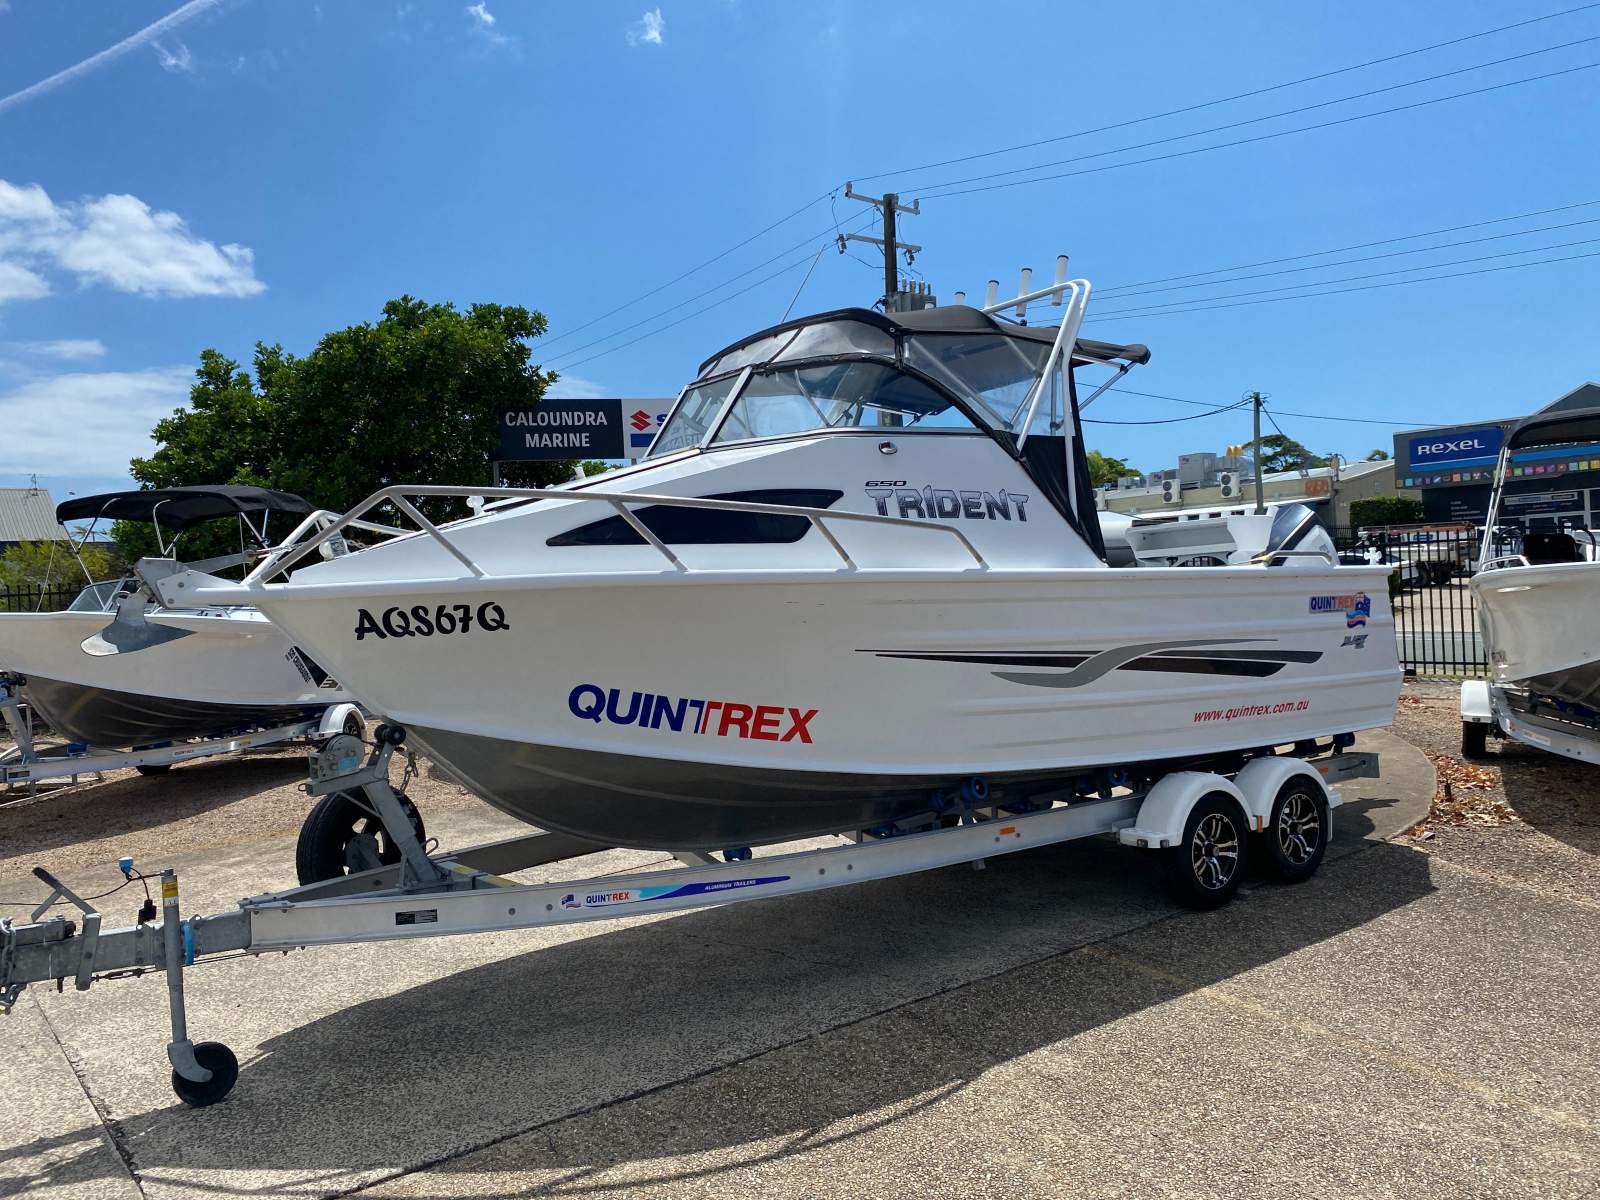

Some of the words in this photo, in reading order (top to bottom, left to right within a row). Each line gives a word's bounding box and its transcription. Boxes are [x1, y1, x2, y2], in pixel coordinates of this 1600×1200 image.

[504, 411, 607, 426] CALOUNDRA
[525, 432, 591, 448] MARINE
[864, 484, 1030, 522] TRIDENT
[355, 601, 510, 641] AQS67Q
[568, 683, 819, 744] QUINTREX
[1193, 700, 1310, 723] www.quintrex.com.au
[586, 891, 630, 904] QUINTREX
